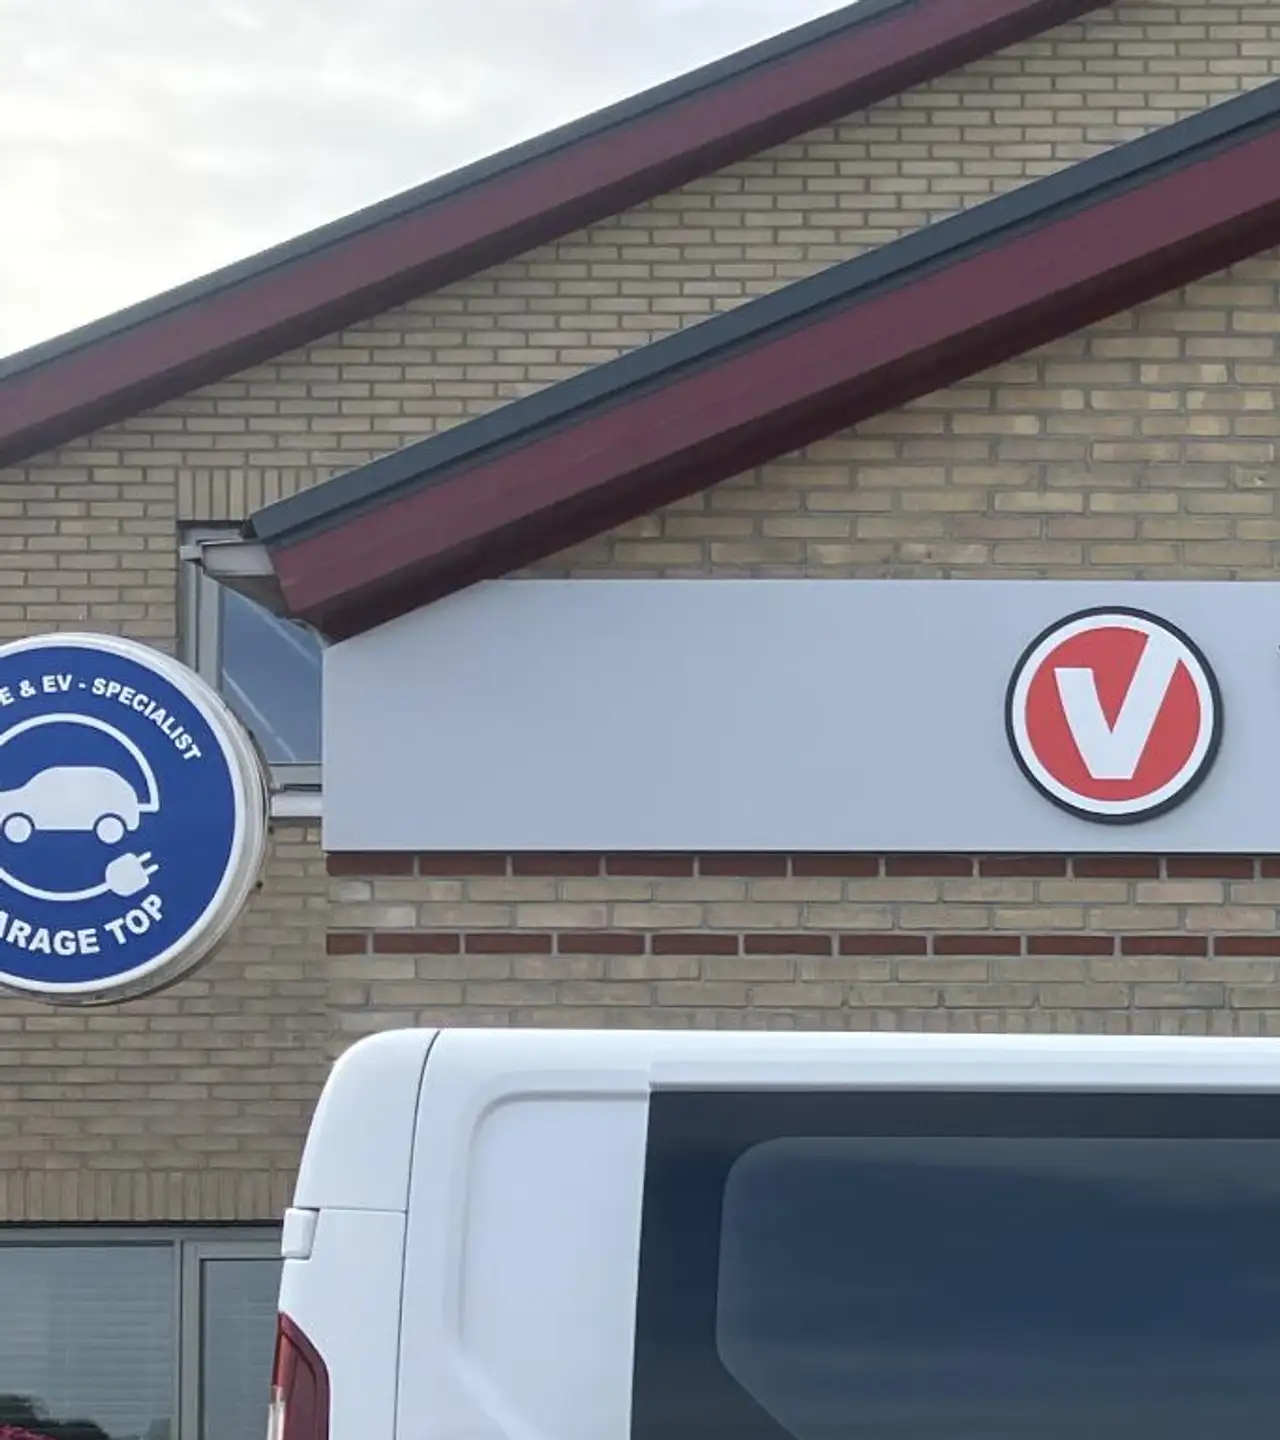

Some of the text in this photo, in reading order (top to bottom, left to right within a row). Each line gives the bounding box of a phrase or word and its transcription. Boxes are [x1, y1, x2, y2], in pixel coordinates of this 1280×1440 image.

[19, 679, 37, 698] &
[41, 674, 73, 693] EV
[92, 677, 202, 760] SPECIALIST
[103, 893, 163, 945] TOP
